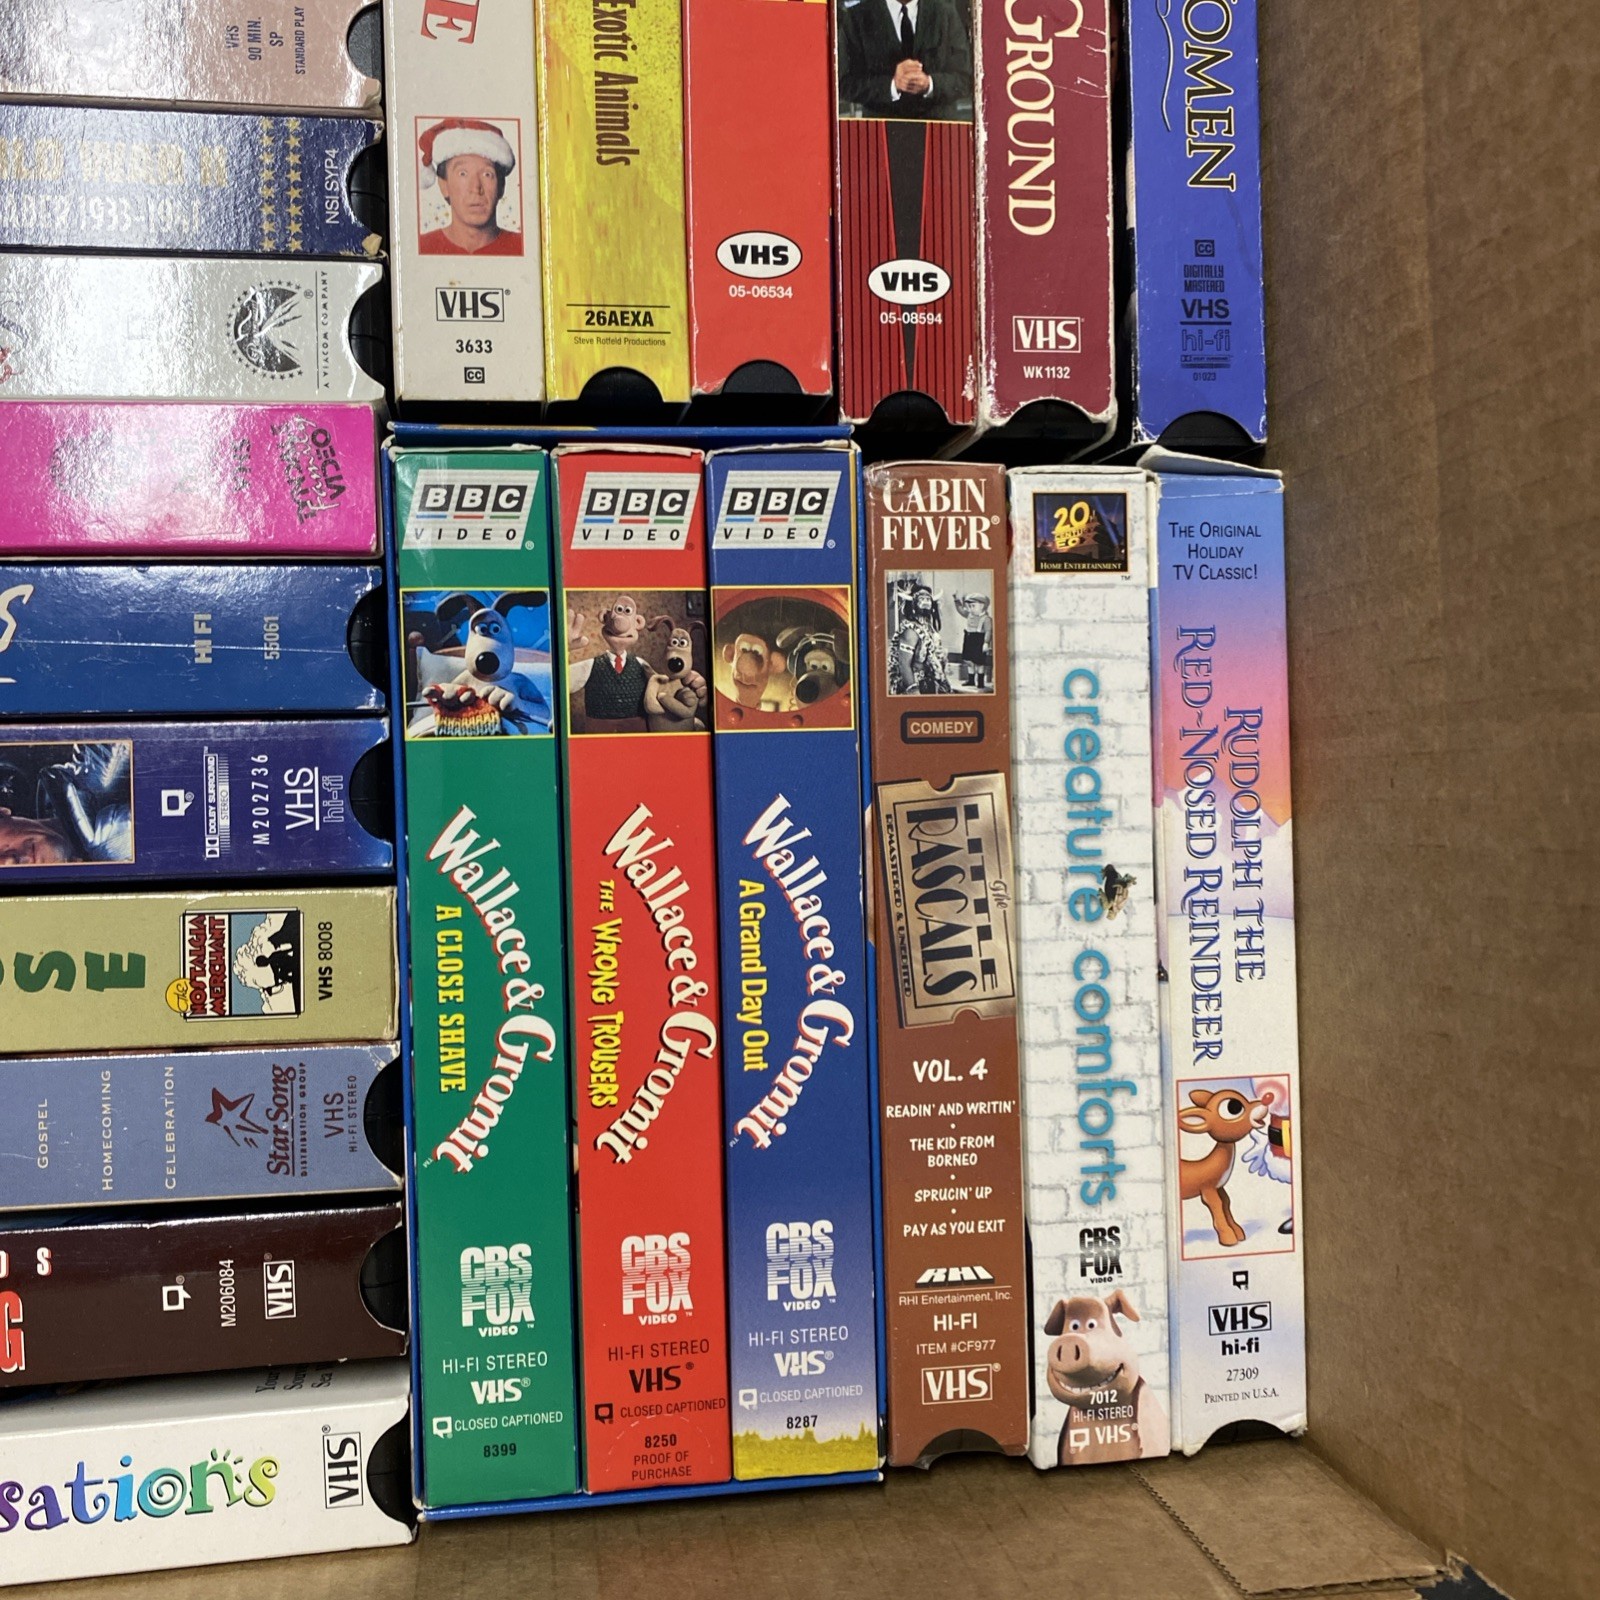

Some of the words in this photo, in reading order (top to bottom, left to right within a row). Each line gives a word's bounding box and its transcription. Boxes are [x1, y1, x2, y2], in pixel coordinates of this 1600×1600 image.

[248, 16, 261, 43] MIN.
[295, 6, 305, 32] PLAY
[593, 0, 638, 61] Exotic
[226, 25, 240, 49] VHS
[270, 31, 284, 47] SP
[249, 46, 262, 60] 90
[295, 34, 305, 75] STANDARD
[593, 70, 640, 166] Animals
[324, 148, 339, 193] SYP4
[325, 197, 340, 225] NSI
[730, 245, 790, 266] VHS
[881, 272, 939, 293] VHS
[1183, 265, 1224, 278] DIGITALLY
[321, 271, 329, 326] COMPANY
[728, 285, 793, 298] 05-06534
[1184, 280, 1225, 292] MASTERED
[440, 291, 500, 319] VHS
[585, 310, 654, 327] 26AEXA
[880, 312, 942, 325] 05-08594
[1181, 299, 1230, 319] VHS
[456, 340, 493, 354] 3633
[574, 336, 594, 346] Steve
[624, 336, 666, 347] Productions
[1018, 320, 1077, 349] VHS
[1182, 330, 1231, 351] hi-fi
[422, 485, 526, 512] BBC
[588, 489, 687, 514] BBC
[729, 488, 825, 513] BBC
[883, 478, 987, 513] CABIN
[413, 528, 518, 541] VIDEO
[581, 529, 681, 541] VIDEO
[722, 528, 819, 540] VIDEO
[1040, 562, 1062, 570] HOME
[1063, 562, 1122, 570] ENTERTAINMENT
[1173, 564, 1194, 580] TV
[263, 616, 281, 660] 55061
[910, 722, 974, 735] COMEDY
[207, 756, 217, 804] SURROUND
[221, 790, 230, 820] STEREO
[251, 755, 270, 845] M202736
[284, 768, 315, 831] VHS
[323, 775, 345, 823] hi-fi
[1063, 668, 1113, 923] creature
[1220, 706, 1264, 890] RUDOLPH
[886, 814, 902, 908] REMASTERED
[426, 804, 532, 975] Wallace
[604, 803, 697, 971] Wallace
[738, 879, 765, 897] A
[743, 794, 835, 959] Wallace
[599, 879, 615, 912] THE
[906, 806, 978, 996] RASCALS
[963, 803, 998, 991] LITTLE
[435, 905, 462, 920] A
[318, 922, 334, 960] 8008
[738, 901, 767, 974] Grand
[1232, 899, 1266, 983] THE
[188, 915, 207, 1015] NOSTALGIA
[208, 915, 227, 1016] MERCHANT
[435, 929, 464, 1003] CLOSE
[587, 918, 622, 1005] WRONG
[1180, 866, 1224, 1065] REINDEER
[319, 971, 334, 1001] VHS
[669, 975, 709, 1007] &
[807, 964, 846, 996] &
[736, 978, 768, 1025] Day
[438, 1013, 466, 1093] SHAVE
[587, 1011, 624, 1108] TROUSERS
[741, 1030, 769, 1071] Out
[735, 999, 855, 1149] Gromit
[913, 1060, 964, 1083] VOL.
[969, 1058, 988, 1081] 4
[1072, 949, 1138, 1206] comforts
[347, 1075, 357, 1122] STEREO
[434, 1014, 557, 1172] Gromit
[595, 1011, 717, 1164] Gromit
[323, 1092, 345, 1139] VHS
[886, 1103, 936, 1118] READIN'
[938, 1102, 964, 1116] AND
[966, 1101, 1016, 1115] WRITIN'
[37, 1098, 49, 1169] GOSPEL
[102, 1069, 114, 1191] HOMECOMING
[164, 1066, 177, 1190] CELEBRATION
[348, 1124, 358, 1152] HI-FI
[910, 1137, 934, 1151] THE
[937, 1136, 957, 1150] KID
[960, 1135, 995, 1149] FROM
[927, 1153, 978, 1168] BORNEO
[914, 1187, 973, 1202] SPRUCIN'
[975, 1186, 993, 1200] UP
[766, 1219, 834, 1260] CBS
[903, 1223, 928, 1237] PAY
[930, 1222, 947, 1236] AS
[950, 1220, 975, 1235] YOU
[977, 1219, 1006, 1233] EXIT
[1079, 1225, 1121, 1251] CBS
[460, 1243, 533, 1284] CBS
[621, 1232, 692, 1272] CBS
[1079, 1253, 1123, 1277] FOX
[219, 1259, 236, 1327] M206084
[266, 1263, 293, 1317] VHS
[621, 1271, 693, 1315] FOX
[766, 1258, 837, 1300] FOX
[461, 1282, 535, 1327] FOX
[783, 1300, 820, 1312] VIDEO
[899, 1295, 920, 1307] RHI
[994, 1289, 1014, 1301] Inc.
[478, 1325, 518, 1338] VIDEO
[638, 1313, 677, 1326] VIDEO
[934, 1313, 978, 1332] HI-FI
[1211, 1304, 1268, 1332] VHS
[608, 1344, 645, 1361] HI-FI
[650, 1338, 710, 1358] STEREO
[748, 1330, 784, 1347] HI-FI
[790, 1325, 849, 1344] STEREO
[917, 1342, 947, 1355] ITEM
[951, 1340, 997, 1353] #CF977
[1221, 1338, 1259, 1355] hi-fi
[442, 1357, 479, 1374] HI-FI
[486, 1352, 548, 1371] STEREO
[773, 1350, 826, 1377] VHS
[1226, 1367, 1259, 1382] 27309
[470, 1378, 522, 1405] VHS
[628, 1365, 682, 1393] VHS
[925, 1368, 989, 1402] VHS
[620, 1403, 662, 1418] CLOSED
[665, 1397, 727, 1415] CAPTIONED
[759, 1390, 801, 1404] CLOSED
[804, 1385, 863, 1400] CAPTIONED
[1089, 1390, 1118, 1404] 7012
[1252, 1388, 1279, 1399] U.S.A.
[454, 1417, 498, 1432] CLOSED
[501, 1411, 564, 1428] CAPTIONED
[786, 1415, 818, 1429] 8287
[1073, 1409, 1096, 1423] HI-FI
[1098, 1406, 1134, 1421] STEREO
[644, 1433, 677, 1449] 8250
[1095, 1424, 1131, 1444] VHS
[483, 1443, 517, 1458] 8399
[633, 1452, 672, 1466] PROOF
[675, 1450, 690, 1463] OF
[327, 1436, 361, 1505] VHS
[631, 1466, 692, 1481] PURCHASE
